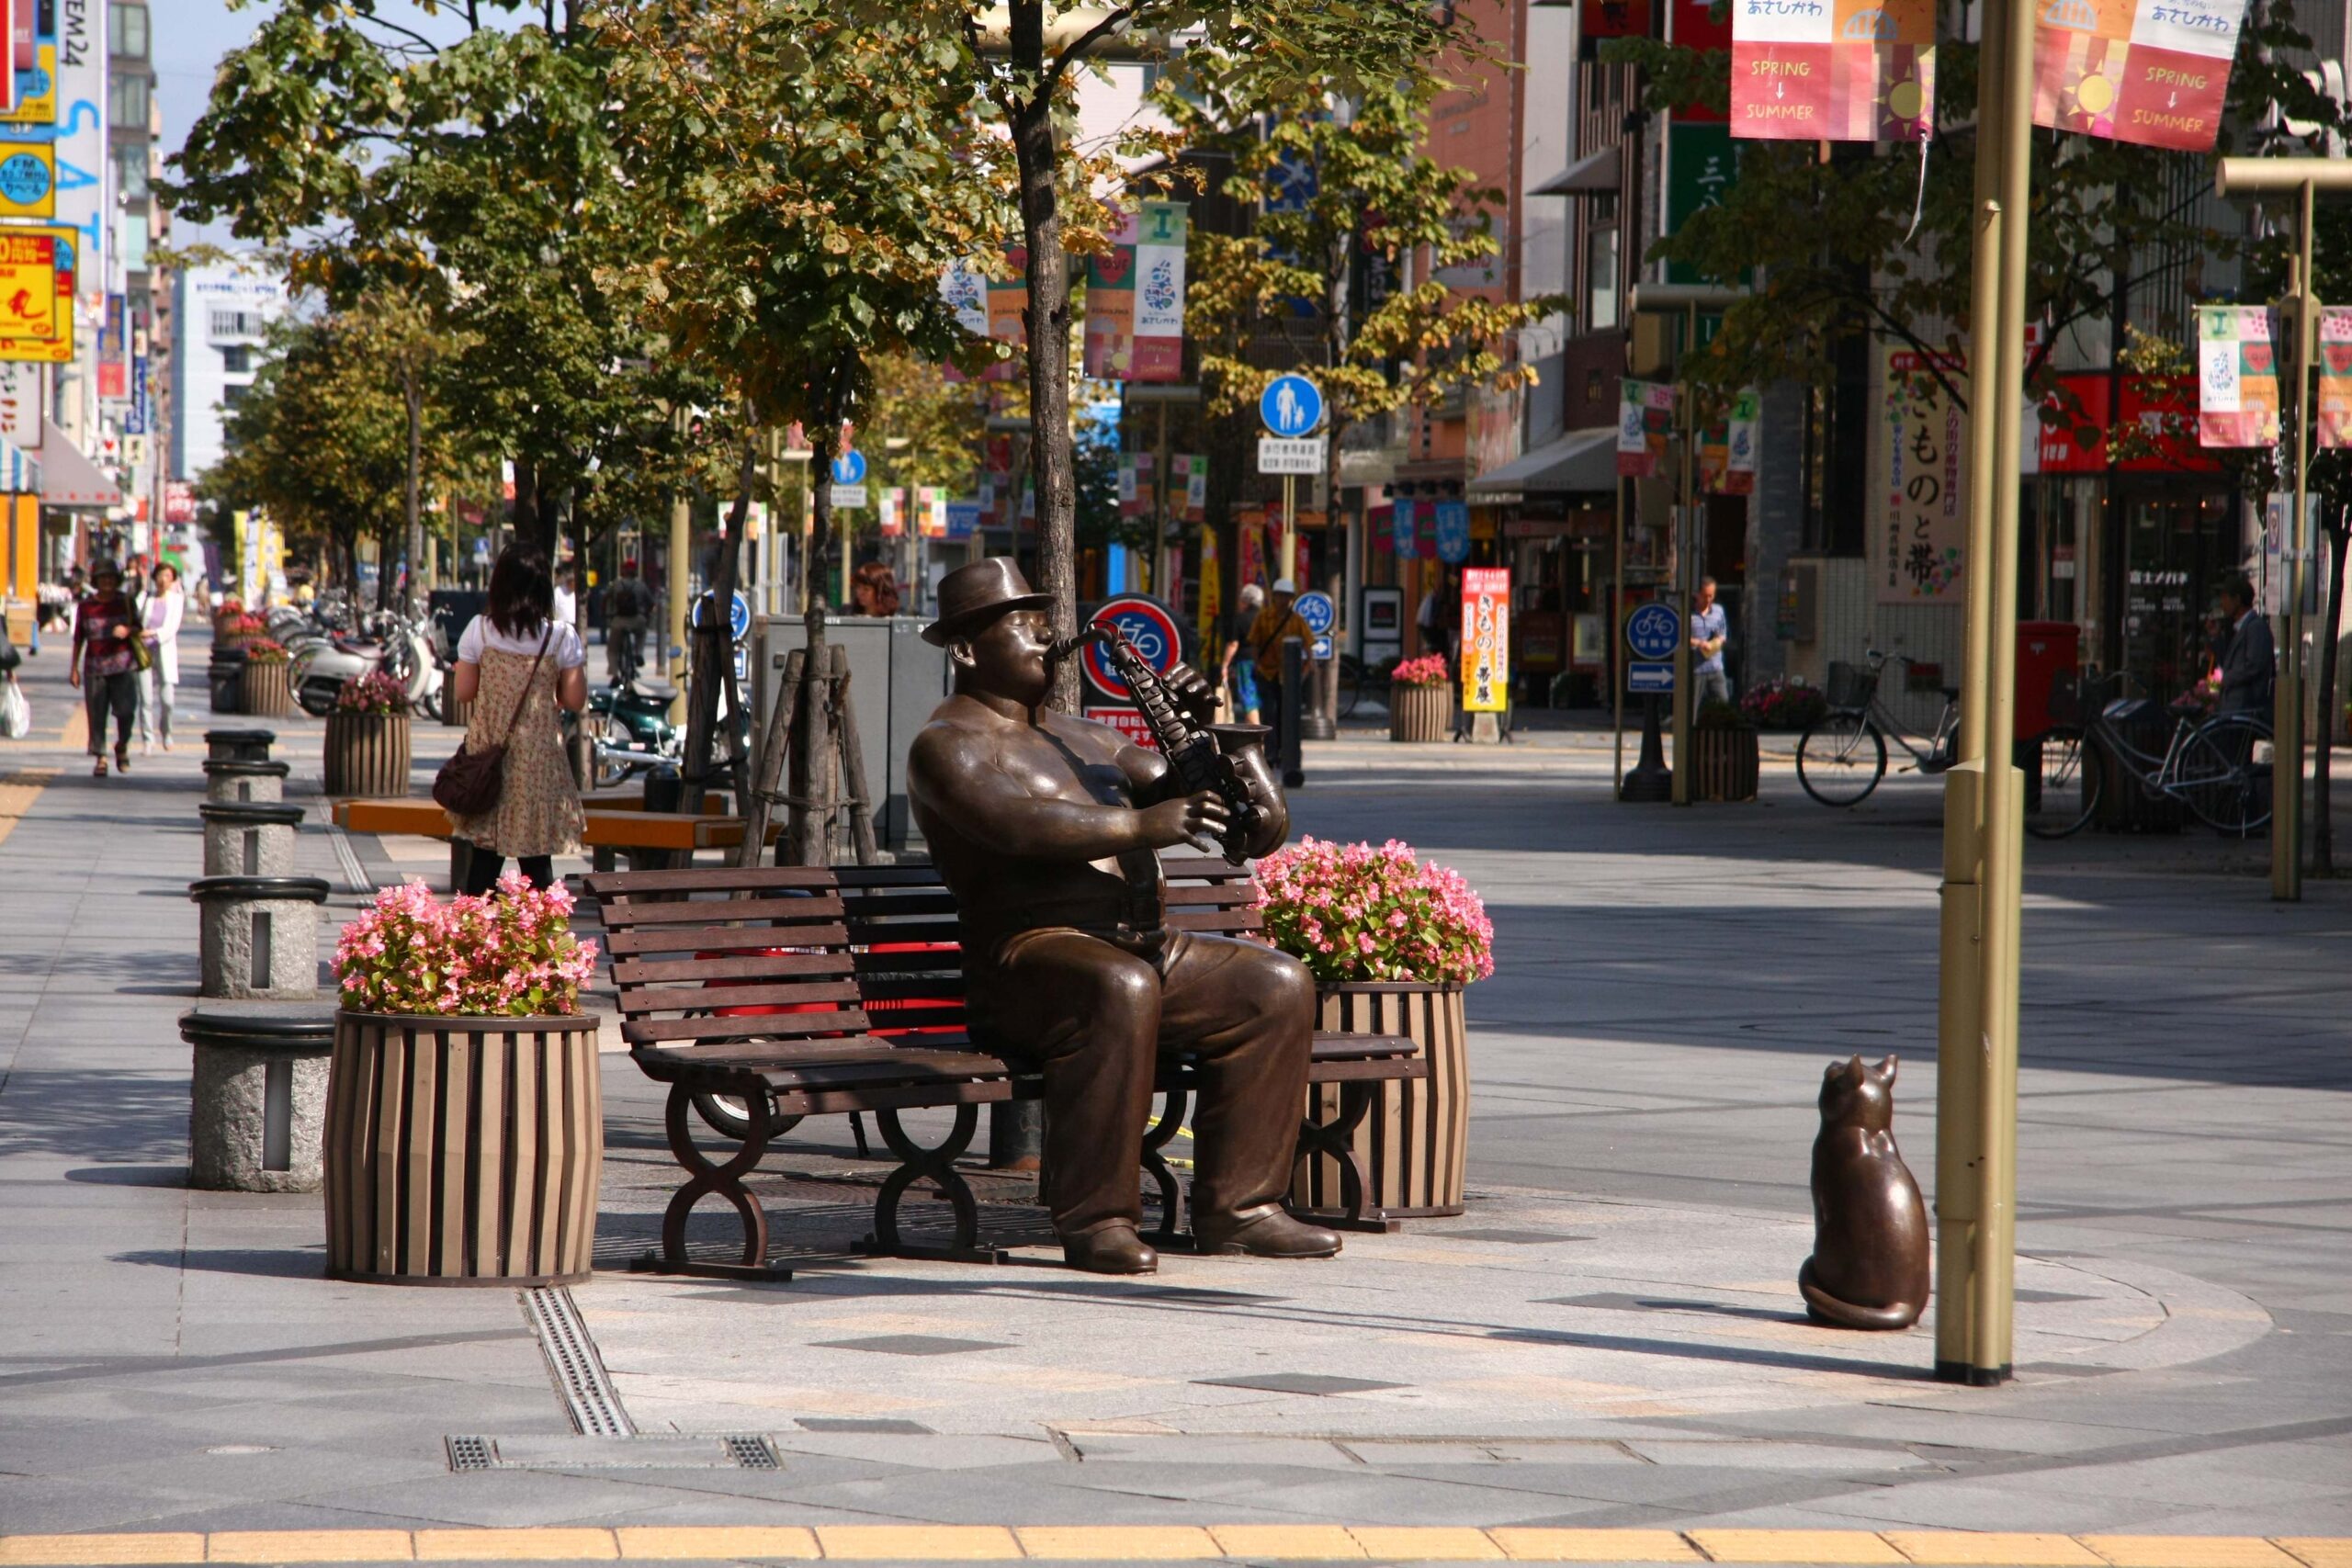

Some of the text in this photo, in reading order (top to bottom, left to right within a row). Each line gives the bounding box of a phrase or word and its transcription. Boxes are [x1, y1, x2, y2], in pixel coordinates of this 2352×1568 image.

[1747, 1, 1824, 17] あさひかわ
[2152, 6, 2230, 32] あさひかわ
[1747, 103, 1814, 120] SUMMER
[2132, 109, 2203, 132] SUMMER
[1153, 209, 1172, 239] I
[2212, 311, 2228, 335] I
